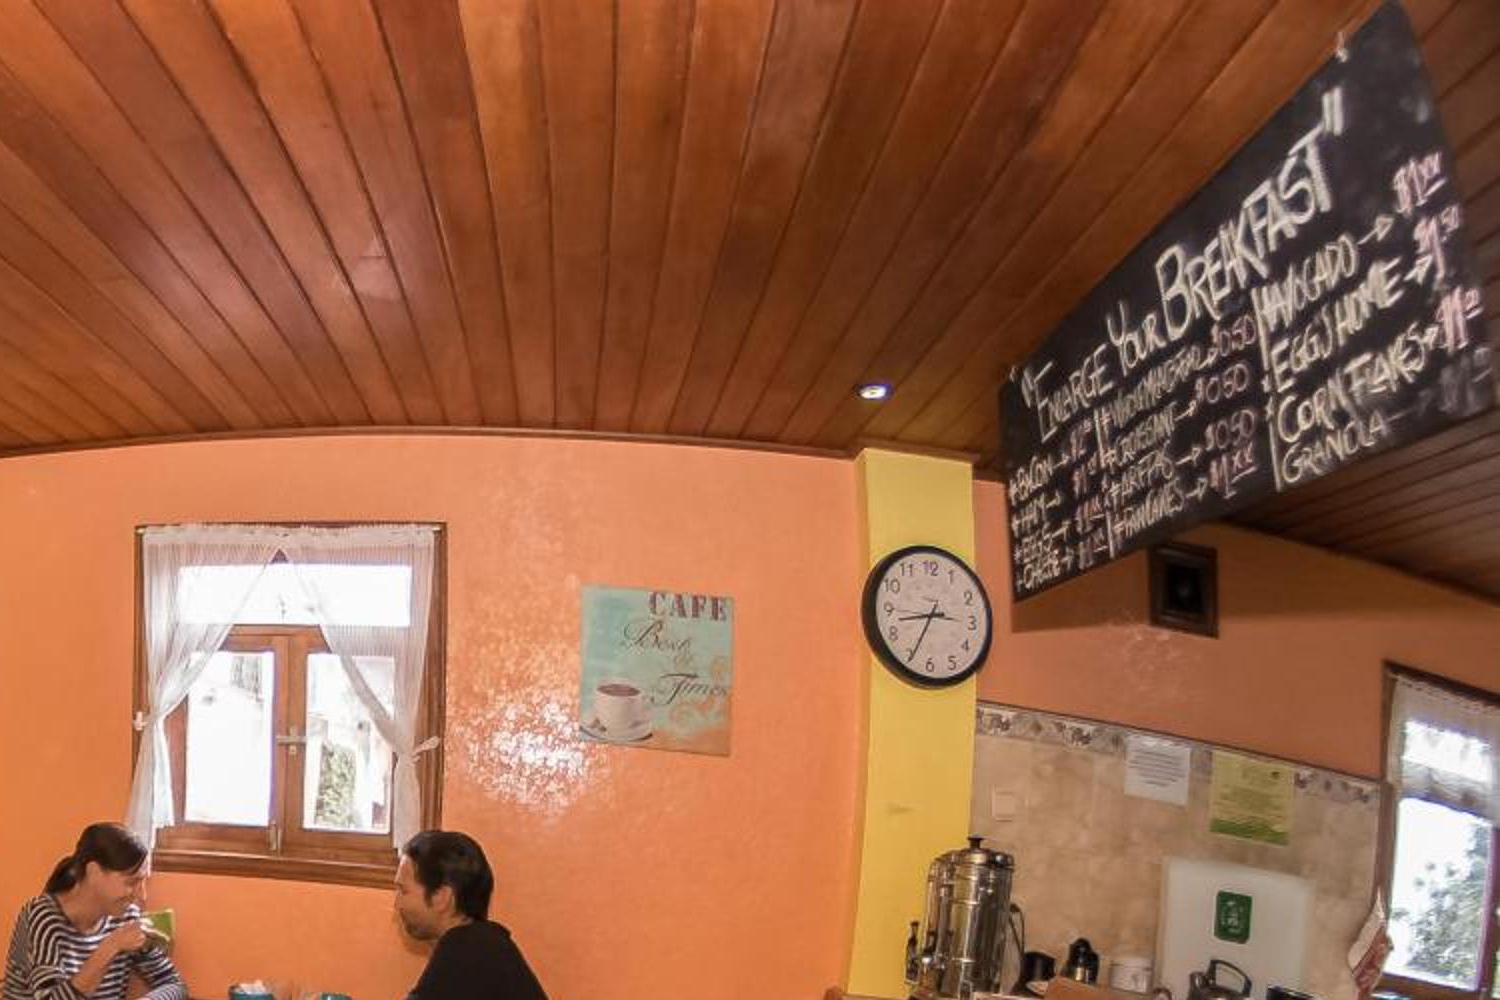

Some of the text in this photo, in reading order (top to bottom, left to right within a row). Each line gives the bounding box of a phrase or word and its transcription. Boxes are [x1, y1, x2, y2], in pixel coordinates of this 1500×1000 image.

[1106, 301, 1167, 377] YOUR
[1277, 368, 1350, 443] CORN
[1282, 409, 1388, 484] GRANOLA
[900, 562, 914, 577] 11
[922, 560, 939, 576] 12
[947, 569, 955, 584] 1
[884, 578, 901, 594] 10
[649, 591, 728, 621] CAFE
[963, 590, 973, 606] 2
[883, 601, 895, 617] 9
[967, 615, 977, 631] 3
[888, 625, 899, 641] 8
[960, 638, 970, 652] 4
[925, 656, 935, 673] 6
[947, 655, 957, 671] 5
